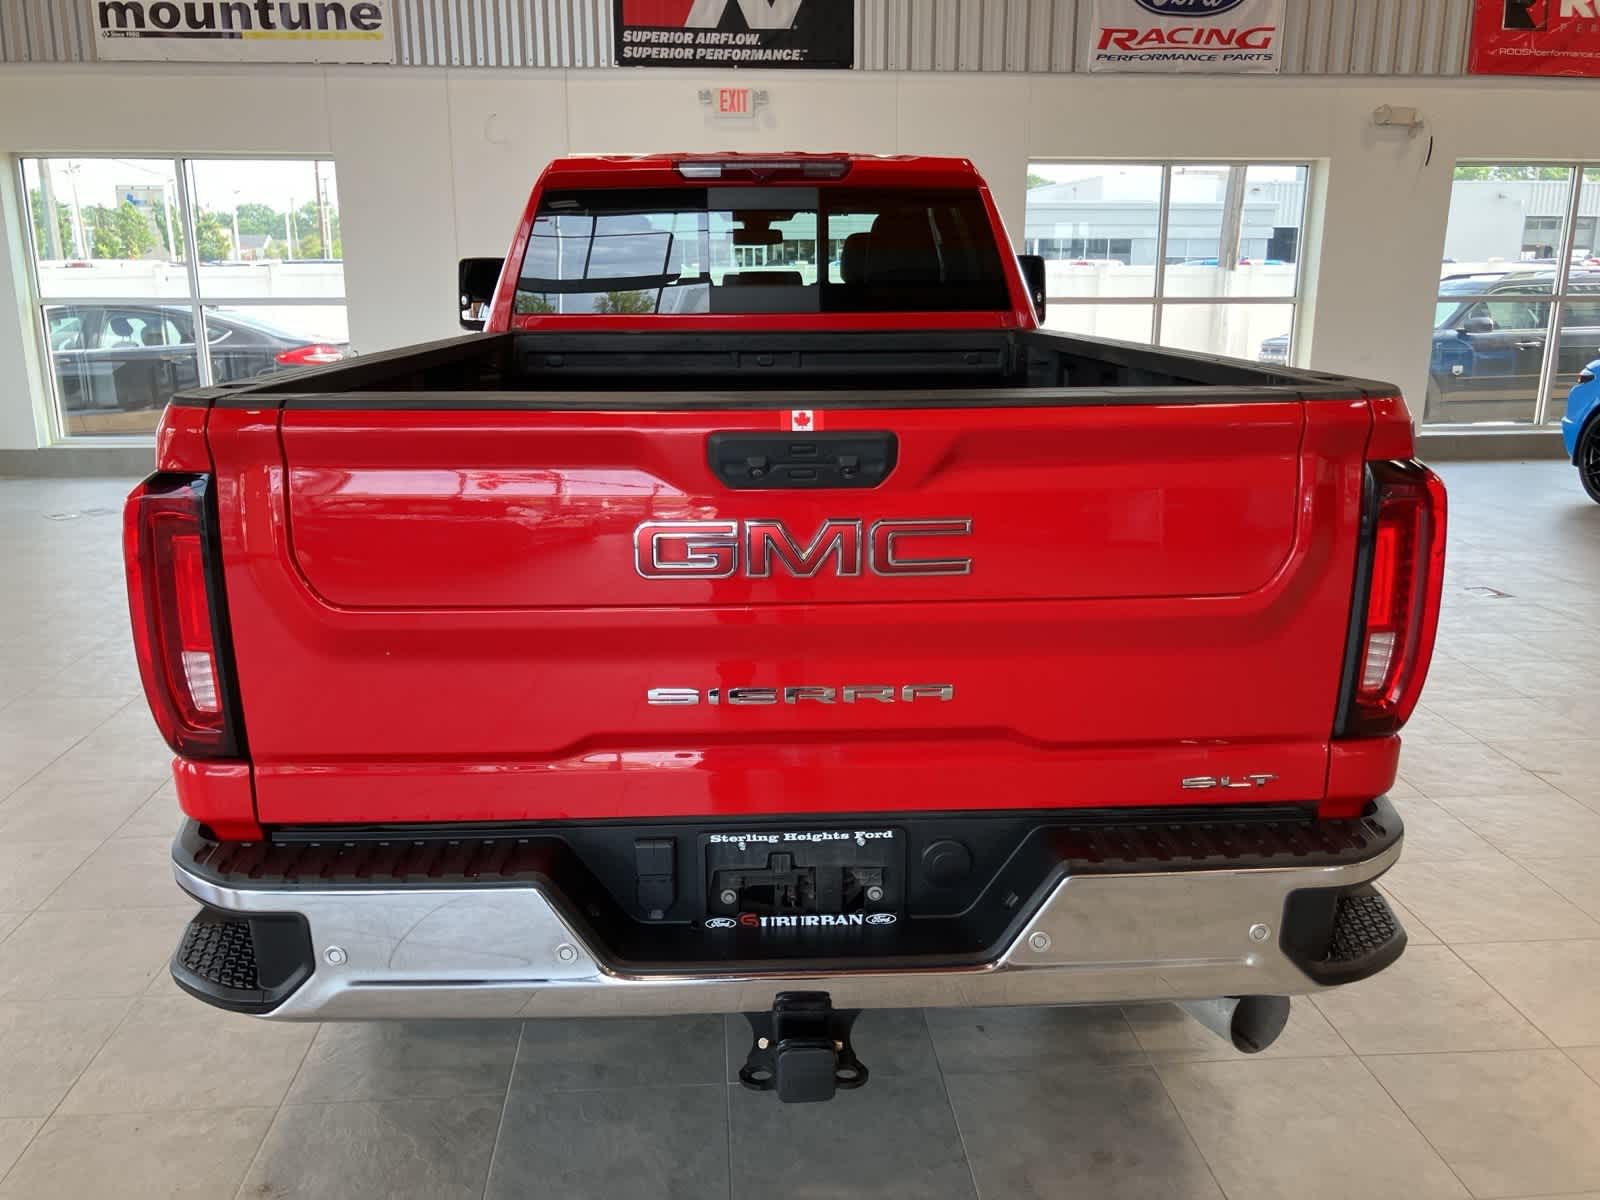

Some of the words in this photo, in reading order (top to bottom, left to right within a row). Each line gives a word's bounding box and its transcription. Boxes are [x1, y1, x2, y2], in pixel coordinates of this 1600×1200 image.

[99, 0, 383, 31] mountune
[623, 31, 694, 44] SUPERIOR
[696, 33, 761, 46] AIRFLOW.
[1097, 27, 1276, 51] RACING
[623, 46, 694, 60] SUPERIOR
[1096, 53, 1217, 62] PERFORMANCE
[1222, 53, 1273, 61] PARTS
[719, 89, 749, 113] EXIT
[633, 519, 972, 579] GMC
[646, 684, 954, 705] SIERRA
[1181, 773, 1278, 789] SLT
[710, 833, 779, 843] Sterling
[783, 832, 850, 842] Heights
[854, 830, 893, 841] Ford
